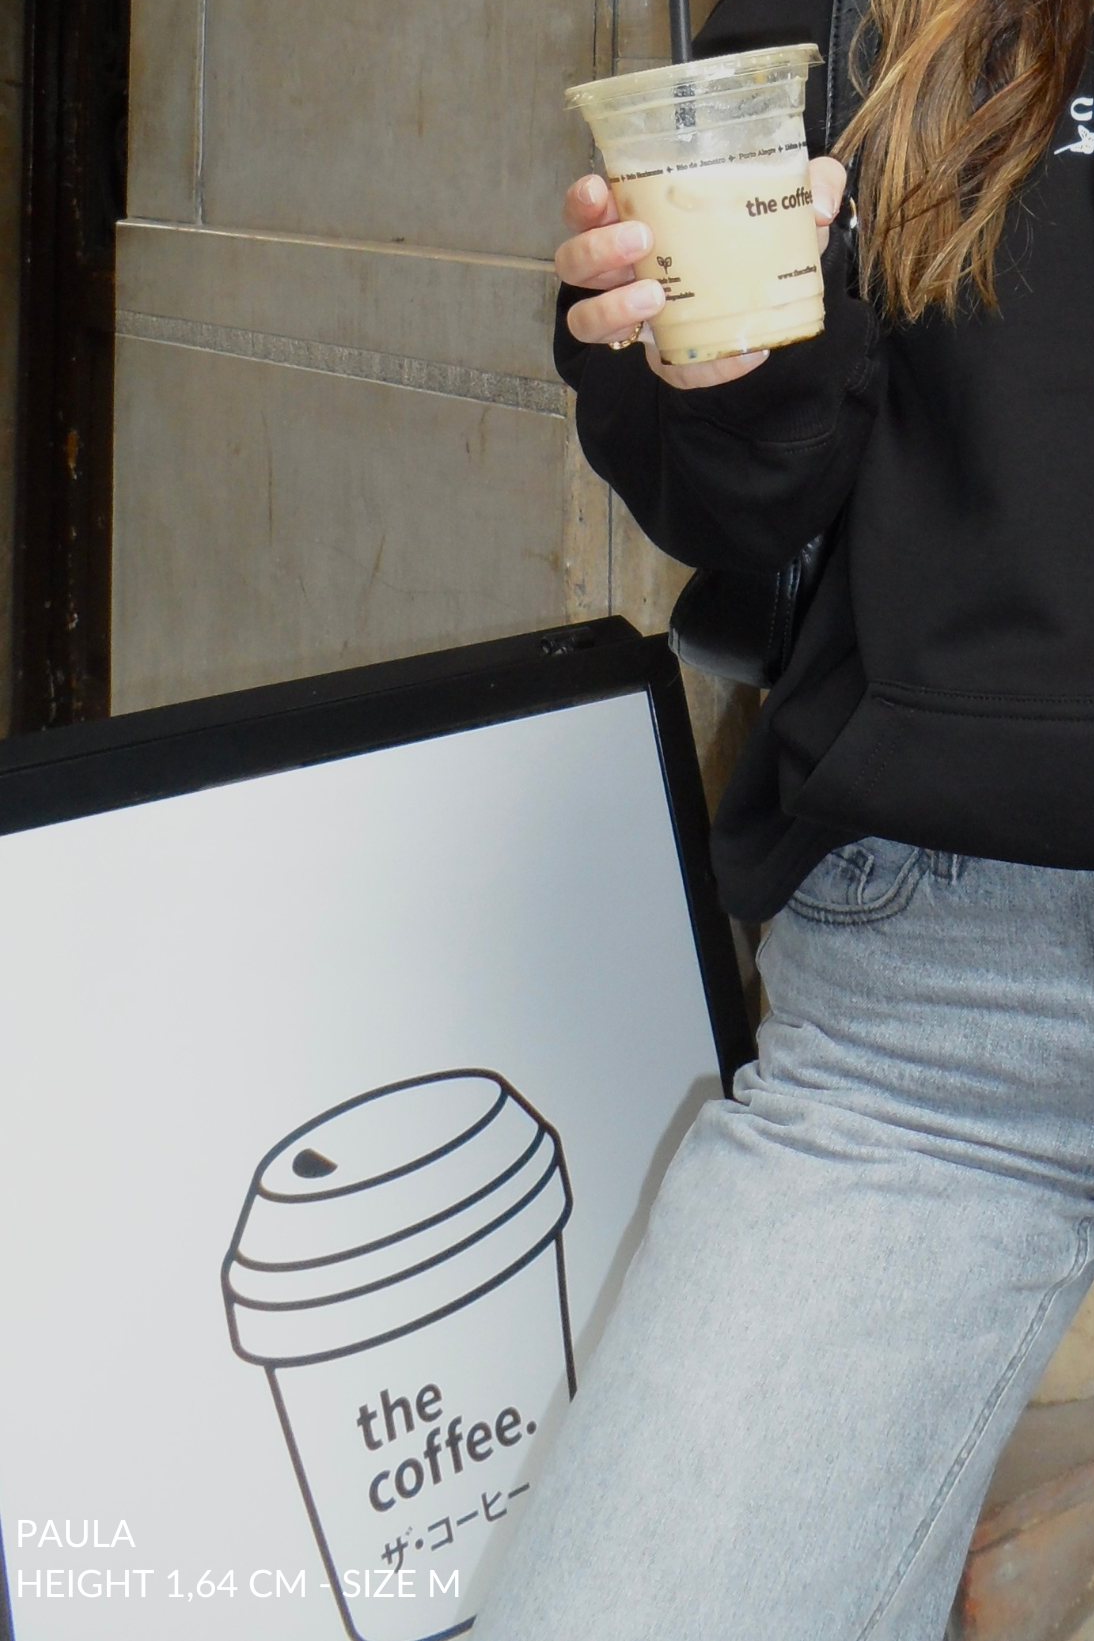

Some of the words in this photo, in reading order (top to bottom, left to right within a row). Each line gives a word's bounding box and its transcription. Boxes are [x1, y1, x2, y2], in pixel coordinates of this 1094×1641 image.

[745, 196, 778, 217] the
[356, 1382, 443, 1451] the
[368, 1405, 538, 1513] coffee.
